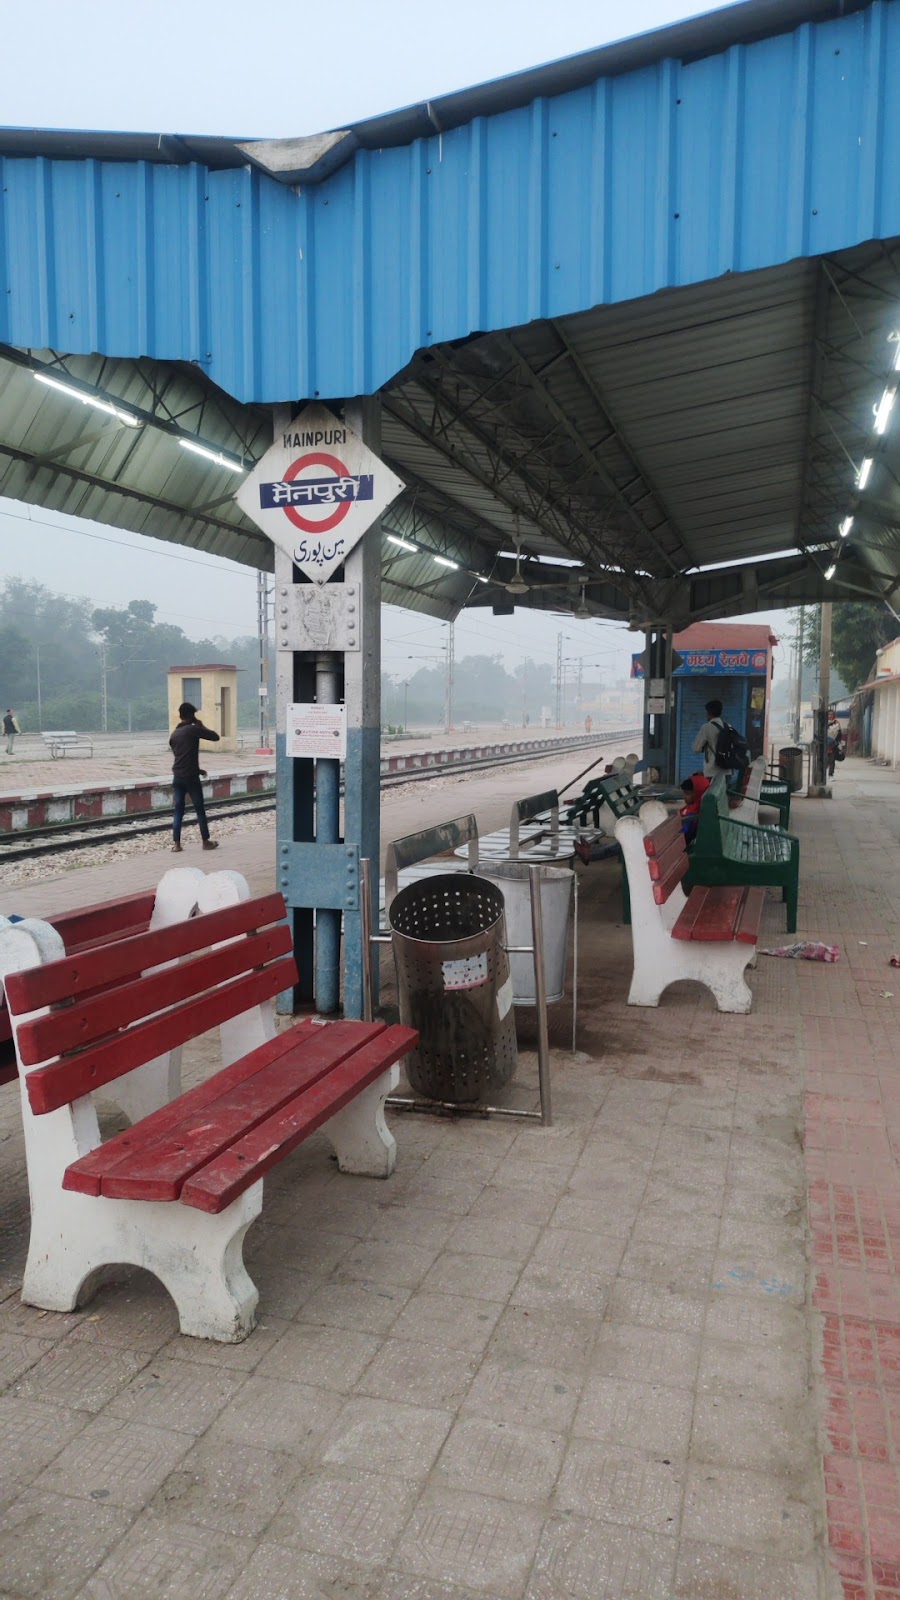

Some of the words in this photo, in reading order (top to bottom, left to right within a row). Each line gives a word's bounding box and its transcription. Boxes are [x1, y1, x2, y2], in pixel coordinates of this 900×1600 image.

[283, 429, 347, 448] MAINPURI
[272, 477, 360, 503] मैनपुरी
[687, 654, 716, 667] मध्य
[720, 651, 750, 667] रेलवे
